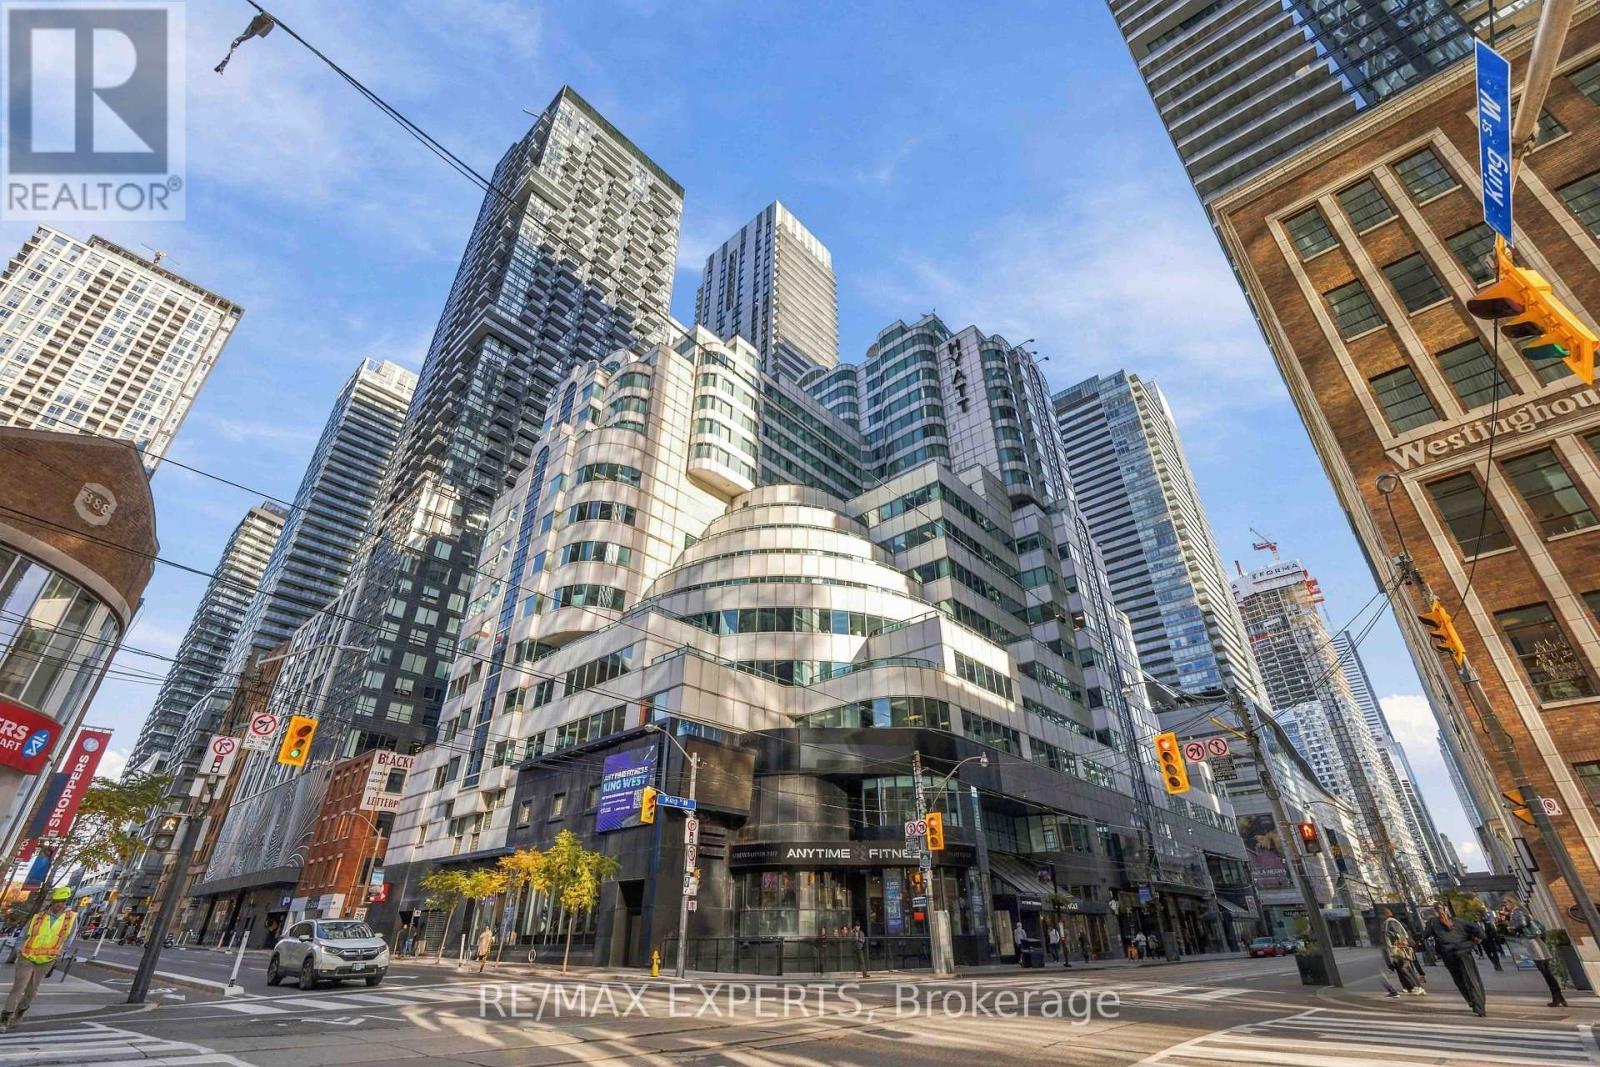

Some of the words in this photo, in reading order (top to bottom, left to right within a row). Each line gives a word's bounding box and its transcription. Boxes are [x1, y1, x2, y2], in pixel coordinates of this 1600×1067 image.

[1480, 88, 1502, 123] W
[1483, 146, 1509, 208] King
[947, 338, 970, 414] HYATT
[1385, 387, 1600, 471] Westinghou
[0, 736, 22, 751] ART
[48, 754, 91, 829] SHOPPERS
[603, 780, 622, 792] KING
[622, 774, 648, 789] WEST
[786, 847, 851, 859] ANYTIME
[868, 847, 920, 859] FITNE
[282, 896, 291, 906] P
